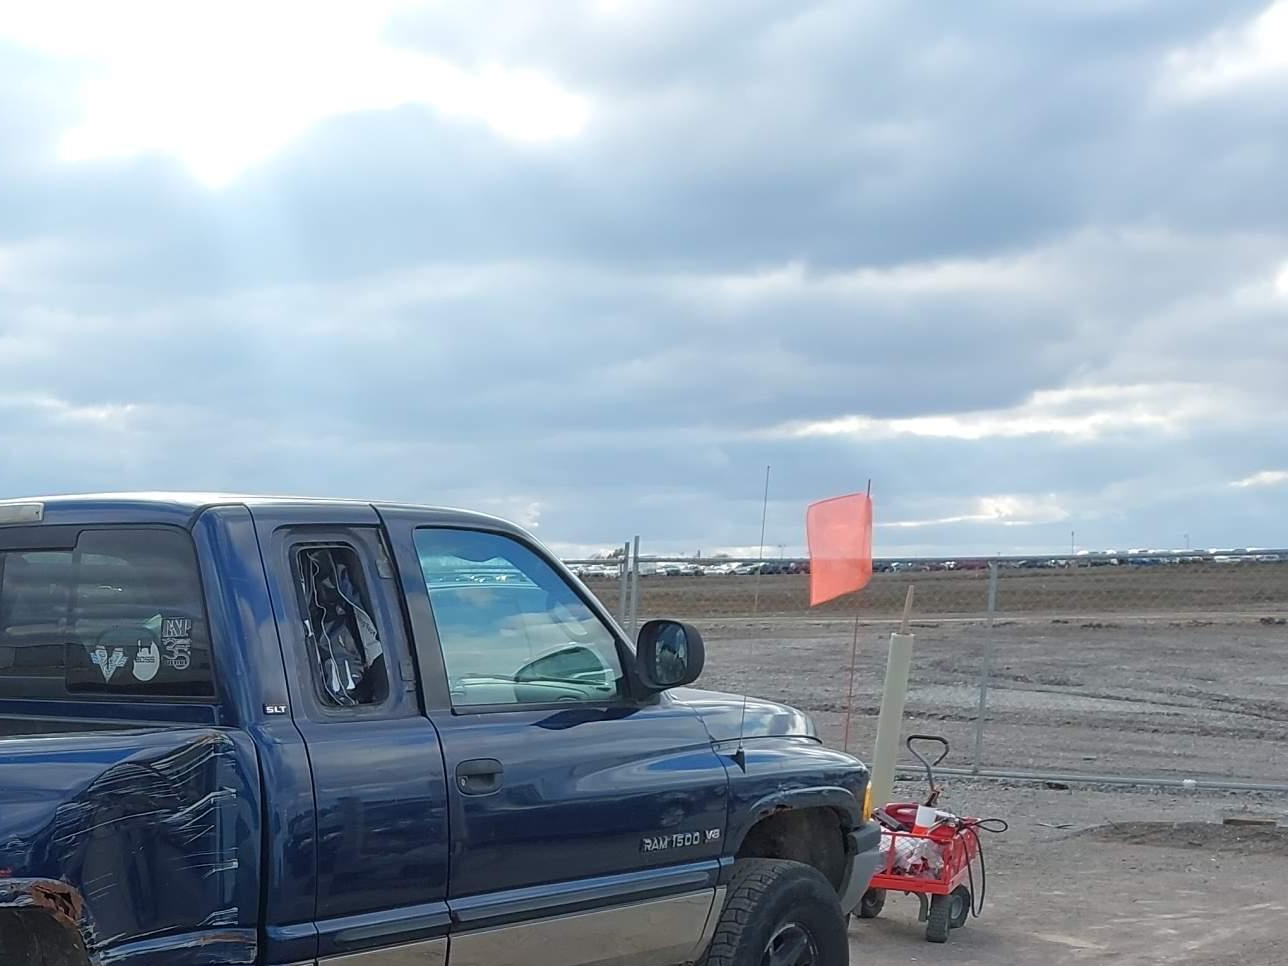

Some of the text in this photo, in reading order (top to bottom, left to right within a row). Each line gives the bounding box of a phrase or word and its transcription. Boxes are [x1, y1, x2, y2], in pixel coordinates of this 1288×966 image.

[266, 705, 287, 713] SLT
[642, 835, 669, 851] RAM
[672, 831, 700, 848] 1500
